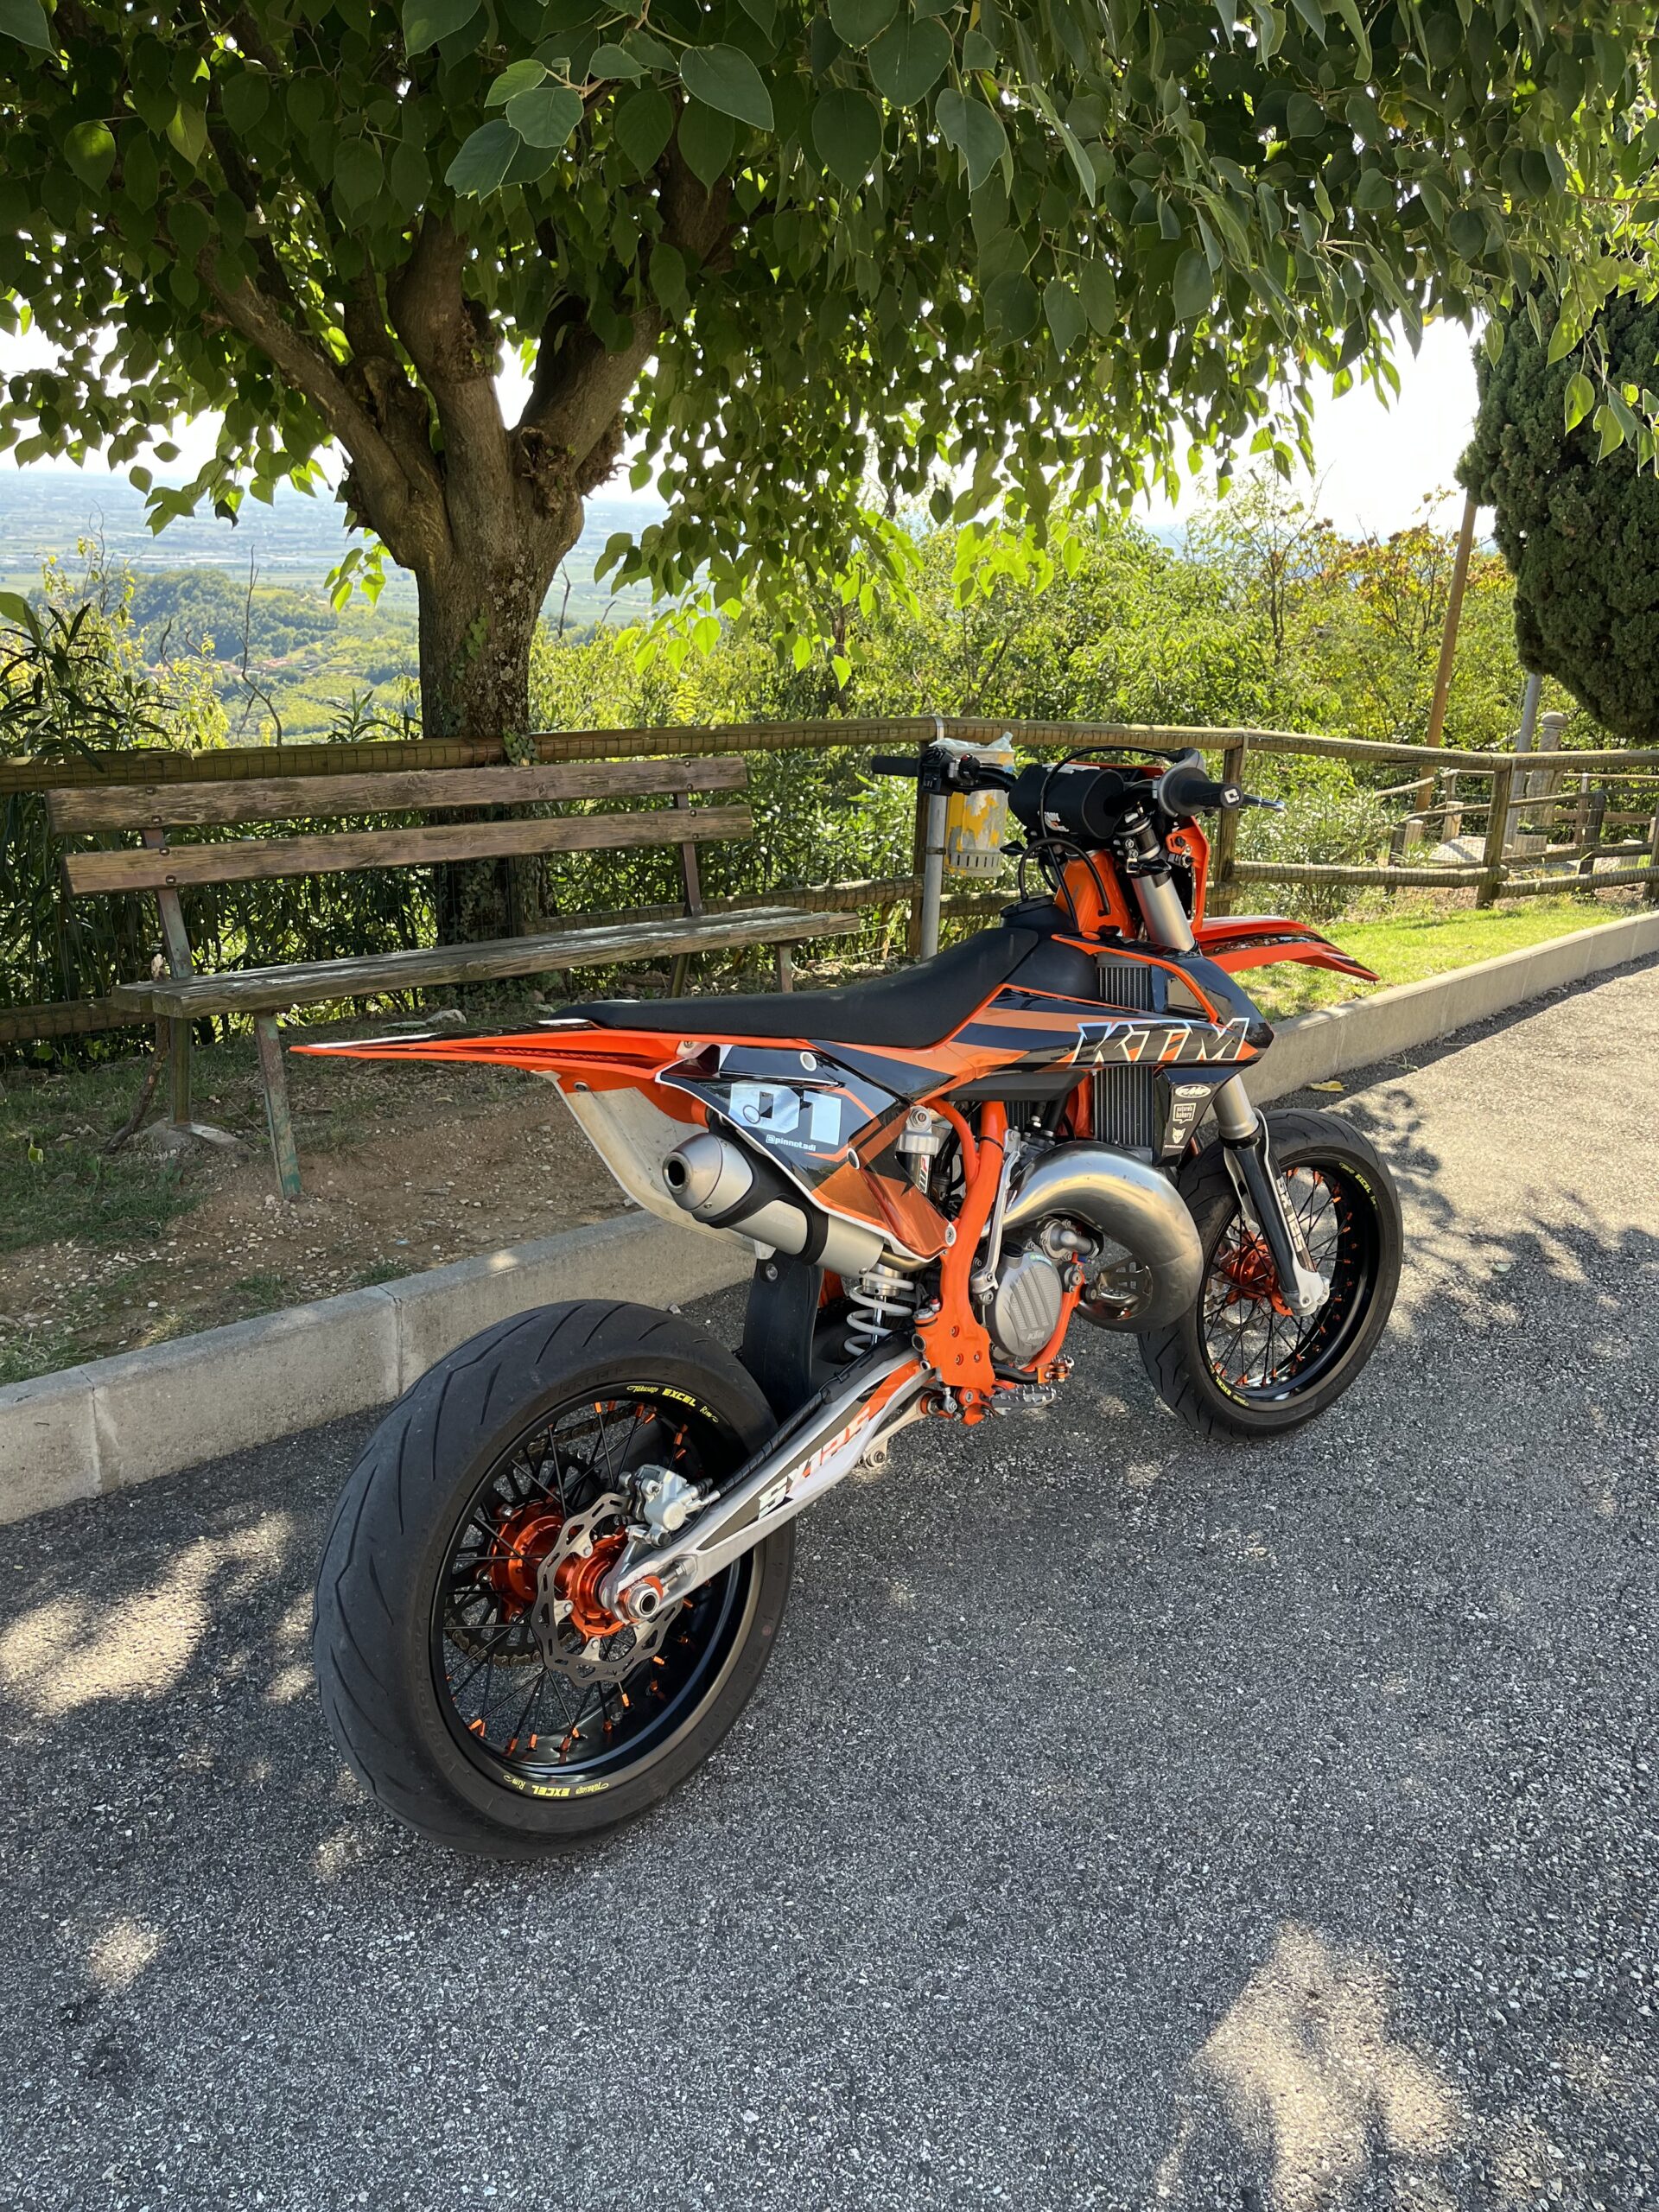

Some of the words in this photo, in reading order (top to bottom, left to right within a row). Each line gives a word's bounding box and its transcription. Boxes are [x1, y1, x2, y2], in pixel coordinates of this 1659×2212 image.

[1068, 1018, 1250, 1069] KTM
[494, 1048, 618, 1061] OMXGRAPHICS
[1177, 1085, 1210, 1096] FMF
[662, 1388, 696, 1407] EXCEL
[700, 1406, 717, 1421] Rim
[531, 1785, 570, 1796] EXCEL
